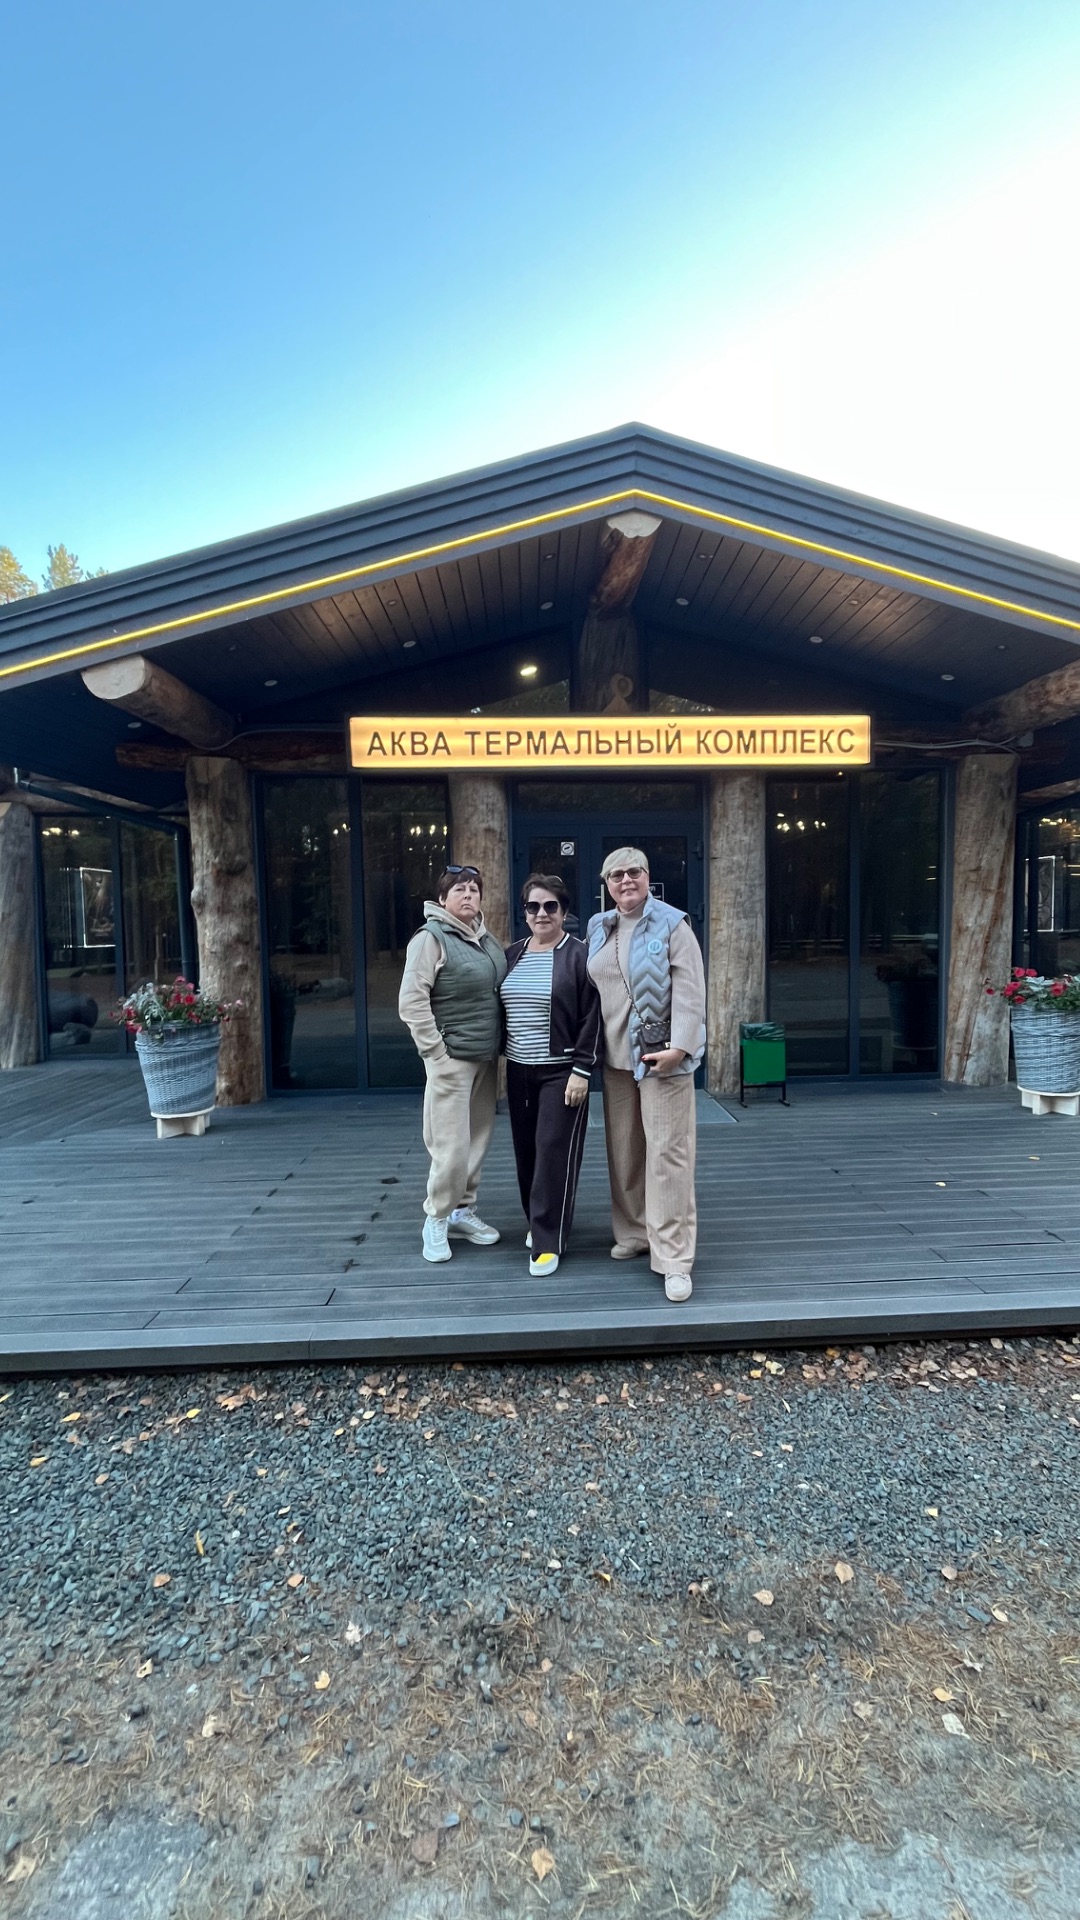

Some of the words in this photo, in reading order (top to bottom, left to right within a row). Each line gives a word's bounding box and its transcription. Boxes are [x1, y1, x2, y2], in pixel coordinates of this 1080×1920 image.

[367, 731, 451, 756] АКВА
[464, 723, 682, 756] ТЕРМАЛЬНЫЙ
[696, 728, 855, 754] КОМПЛЕКС
